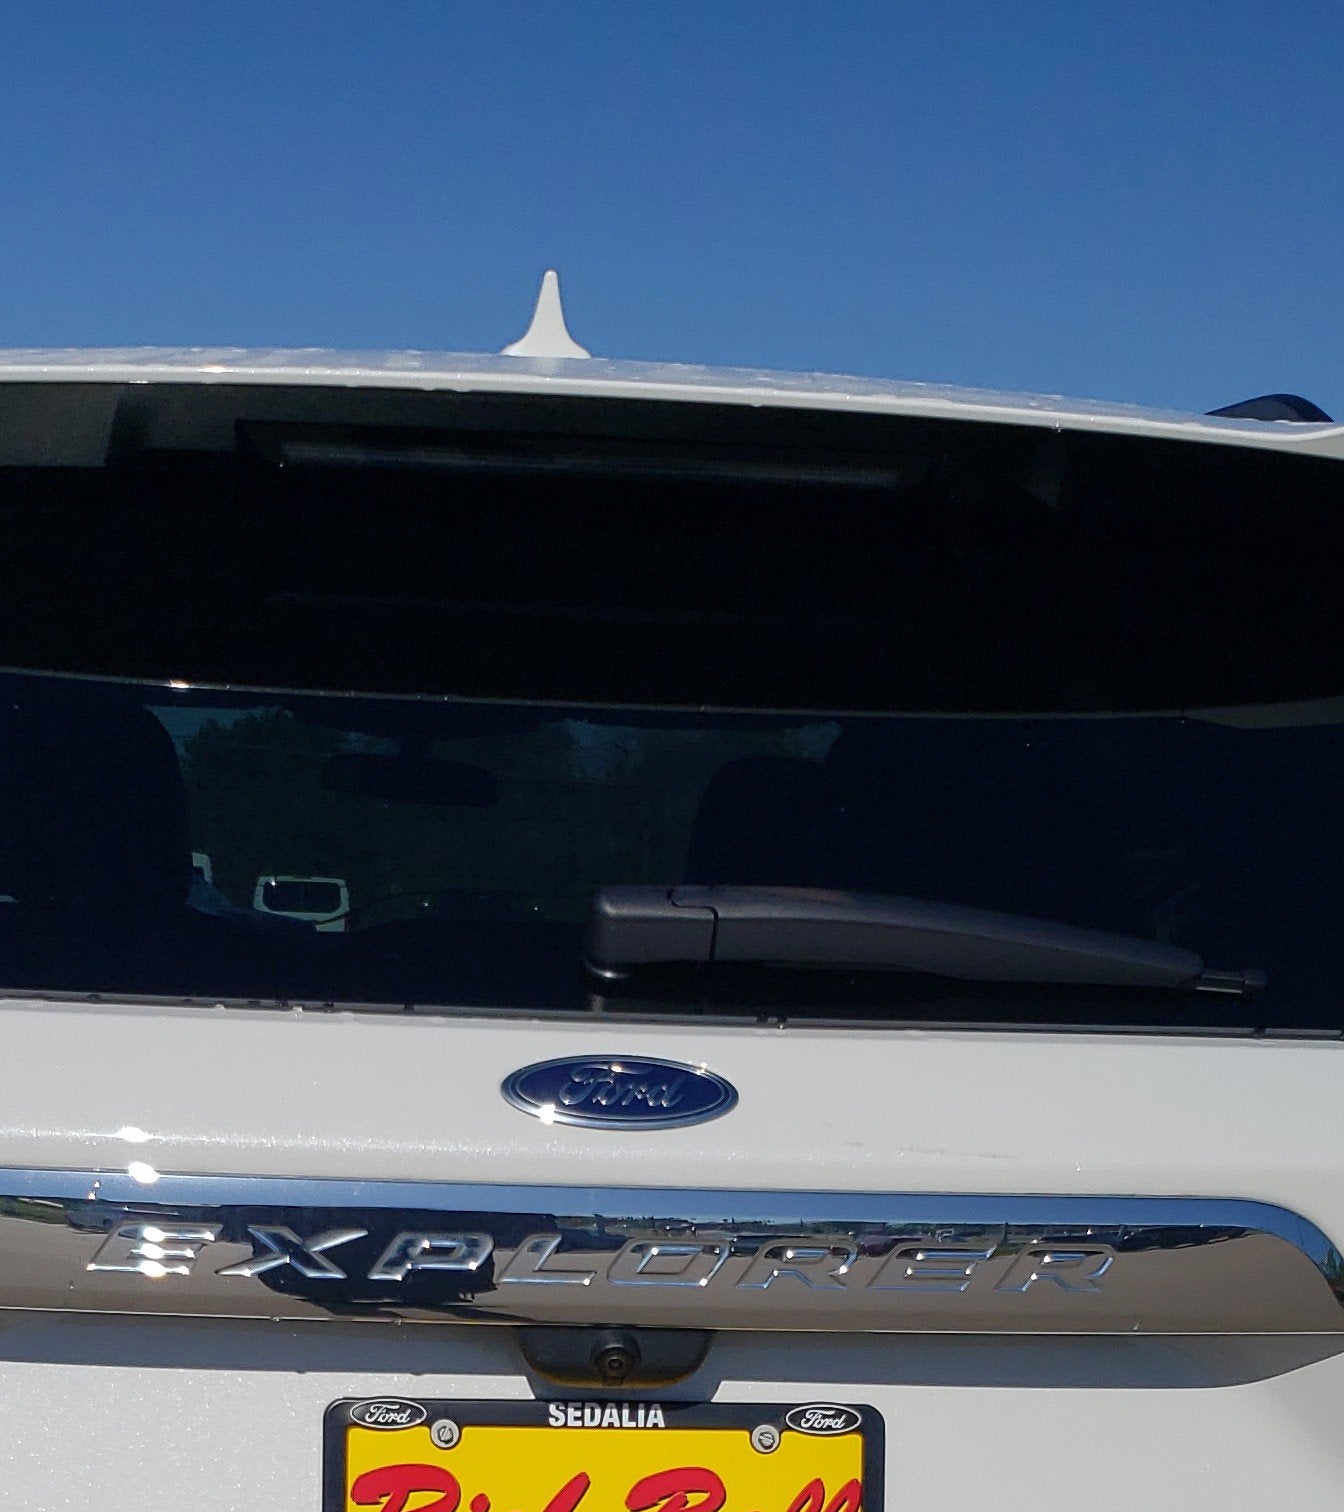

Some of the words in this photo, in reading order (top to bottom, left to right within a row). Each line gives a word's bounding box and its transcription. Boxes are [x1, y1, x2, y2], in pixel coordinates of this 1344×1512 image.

[558, 1062, 688, 1108] Ford
[86, 1219, 1122, 1294] EXPLORER
[365, 1404, 411, 1424] Ford
[548, 1402, 665, 1428] SEDALIA
[800, 1409, 846, 1429] Ford
